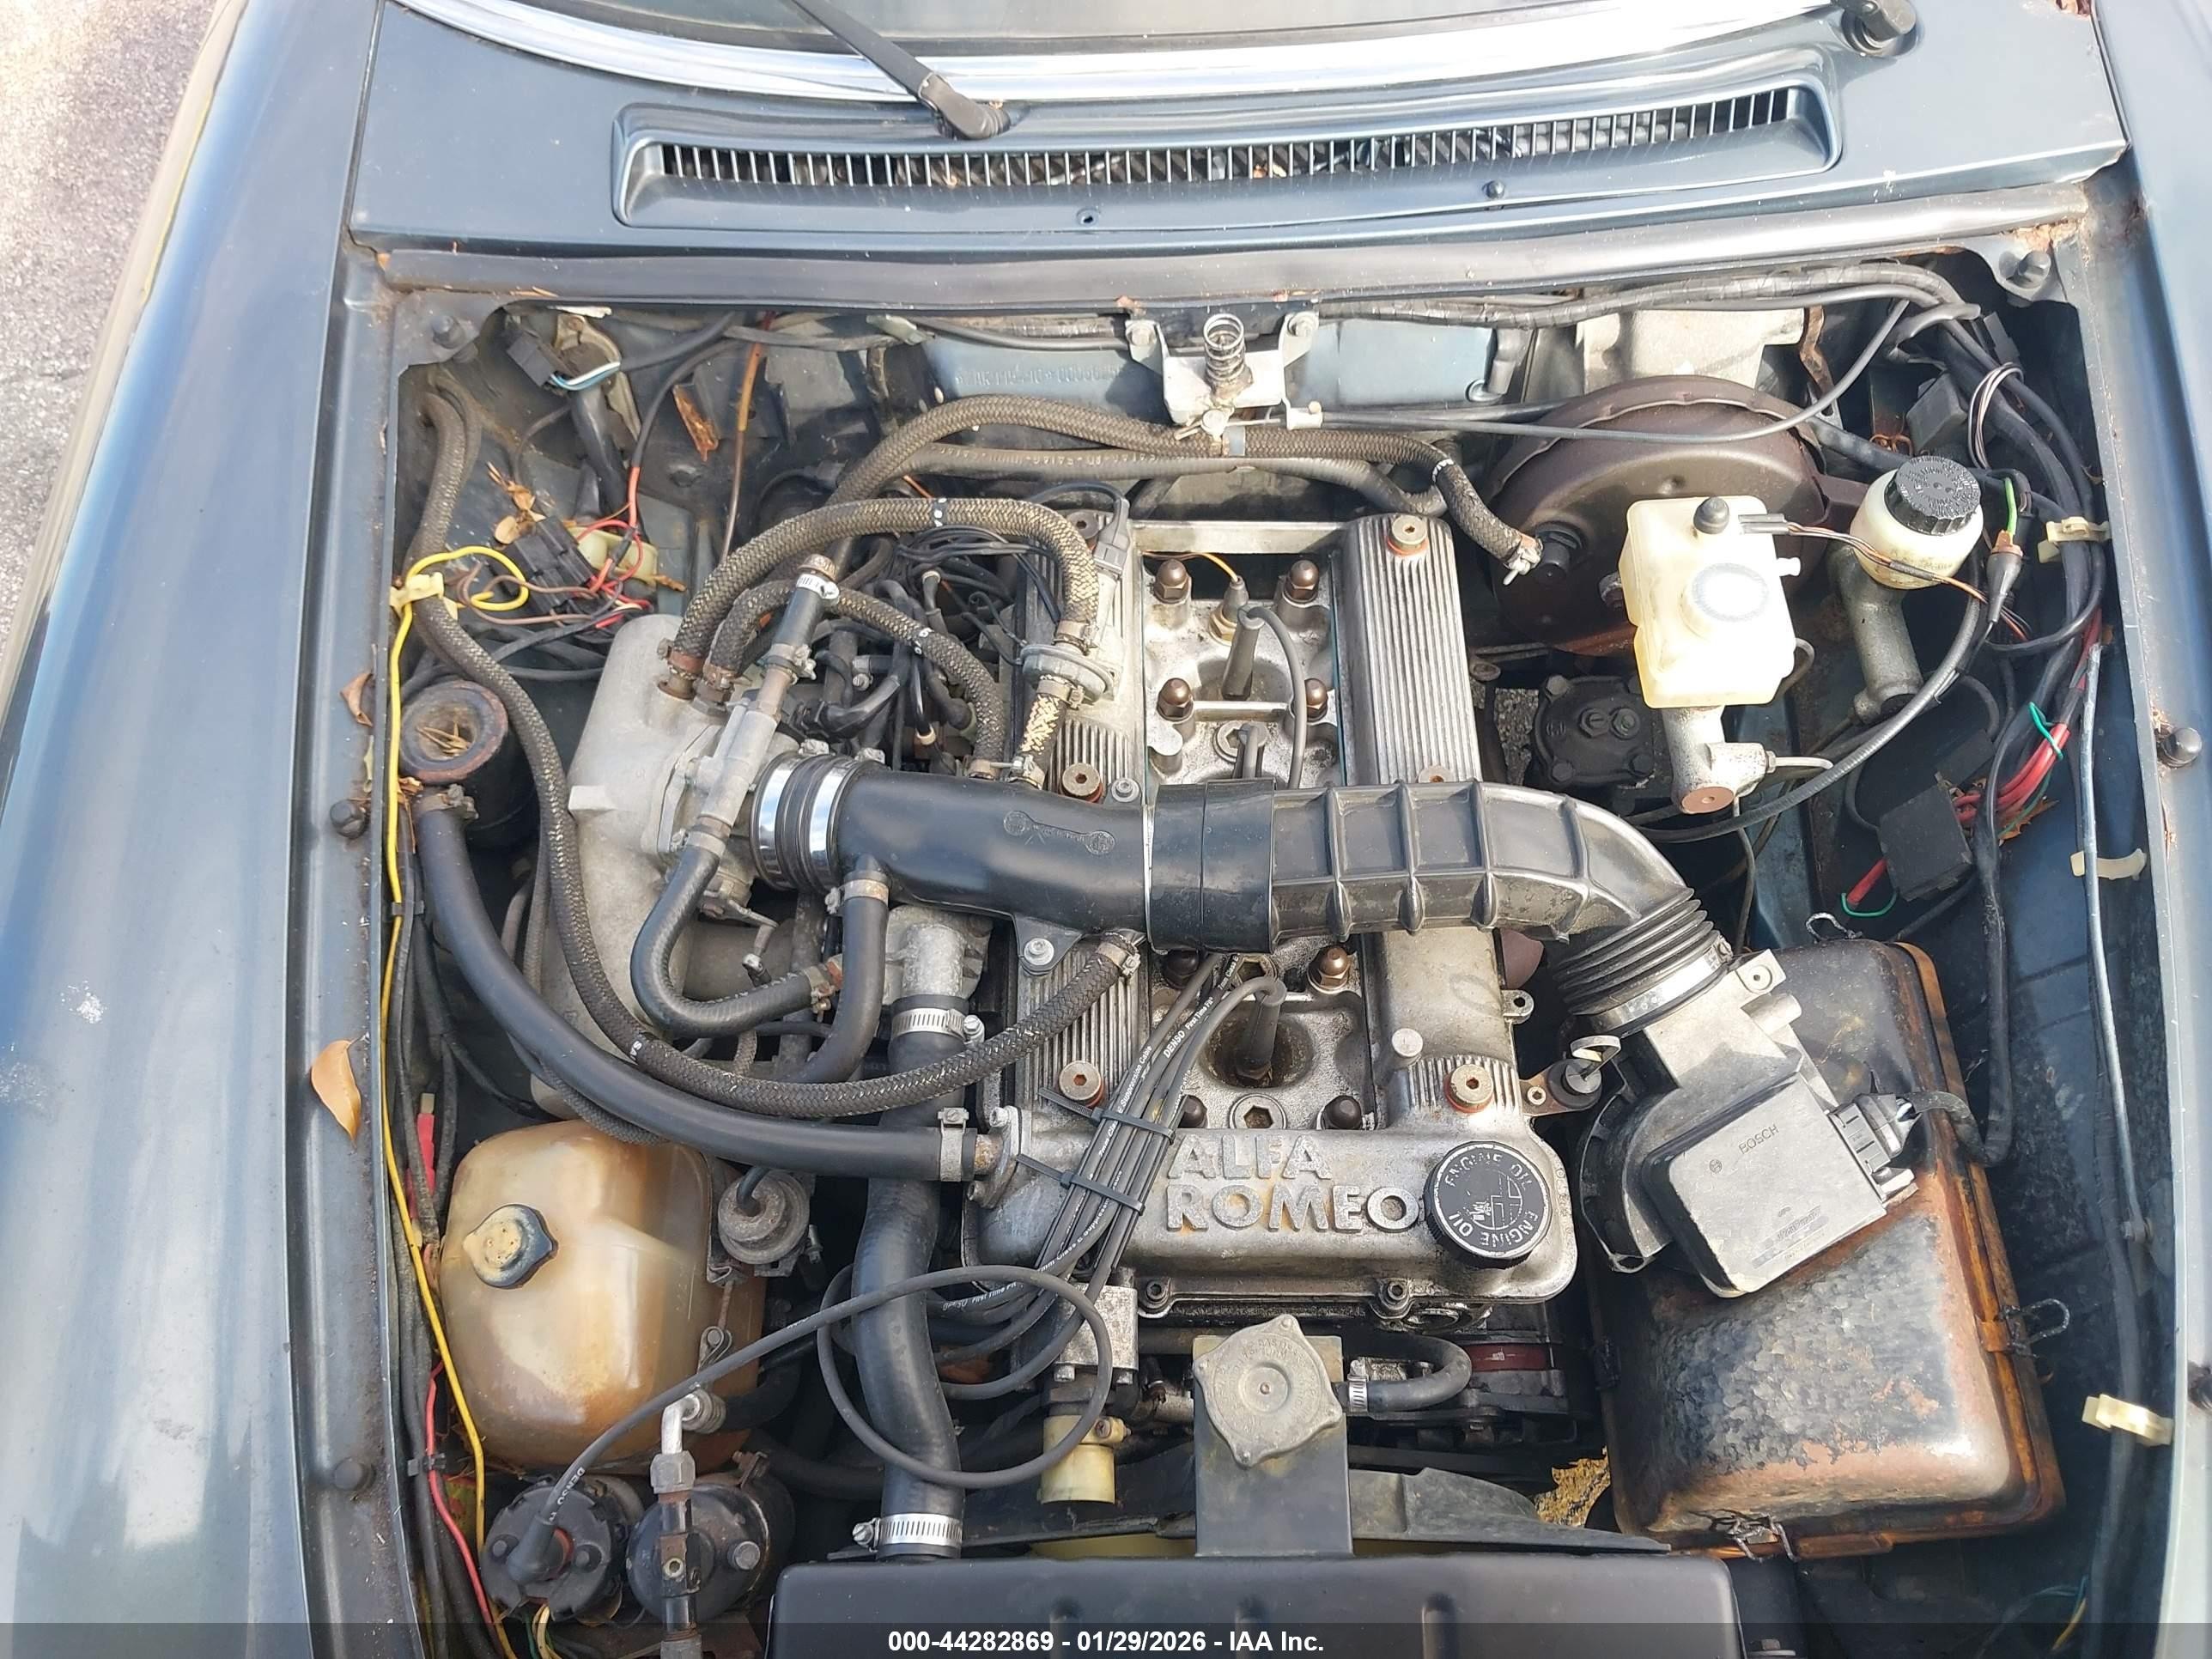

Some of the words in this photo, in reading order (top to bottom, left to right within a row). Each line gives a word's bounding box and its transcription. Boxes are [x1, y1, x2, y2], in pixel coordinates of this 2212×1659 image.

[1163, 1030, 1185, 1059] DENSO
[1185, 1018, 1197, 1030] First
[1195, 1006, 1208, 1019] Time
[1098, 1138, 1110, 1158] 7mm
[1107, 1120, 1118, 1137] Clas
[1120, 1064, 1143, 1107] Suppression
[1139, 1045, 1152, 1065] Cable
[1168, 1133, 1333, 1180] ALFA
[1738, 1124, 1779, 1155] BOSCH
[1166, 1183, 1419, 1233] ROMEO
[1448, 1211, 1474, 1237] OIL
[1479, 1210, 1539, 1248] ENGINE
[556, 1467, 586, 1505] DENSO
